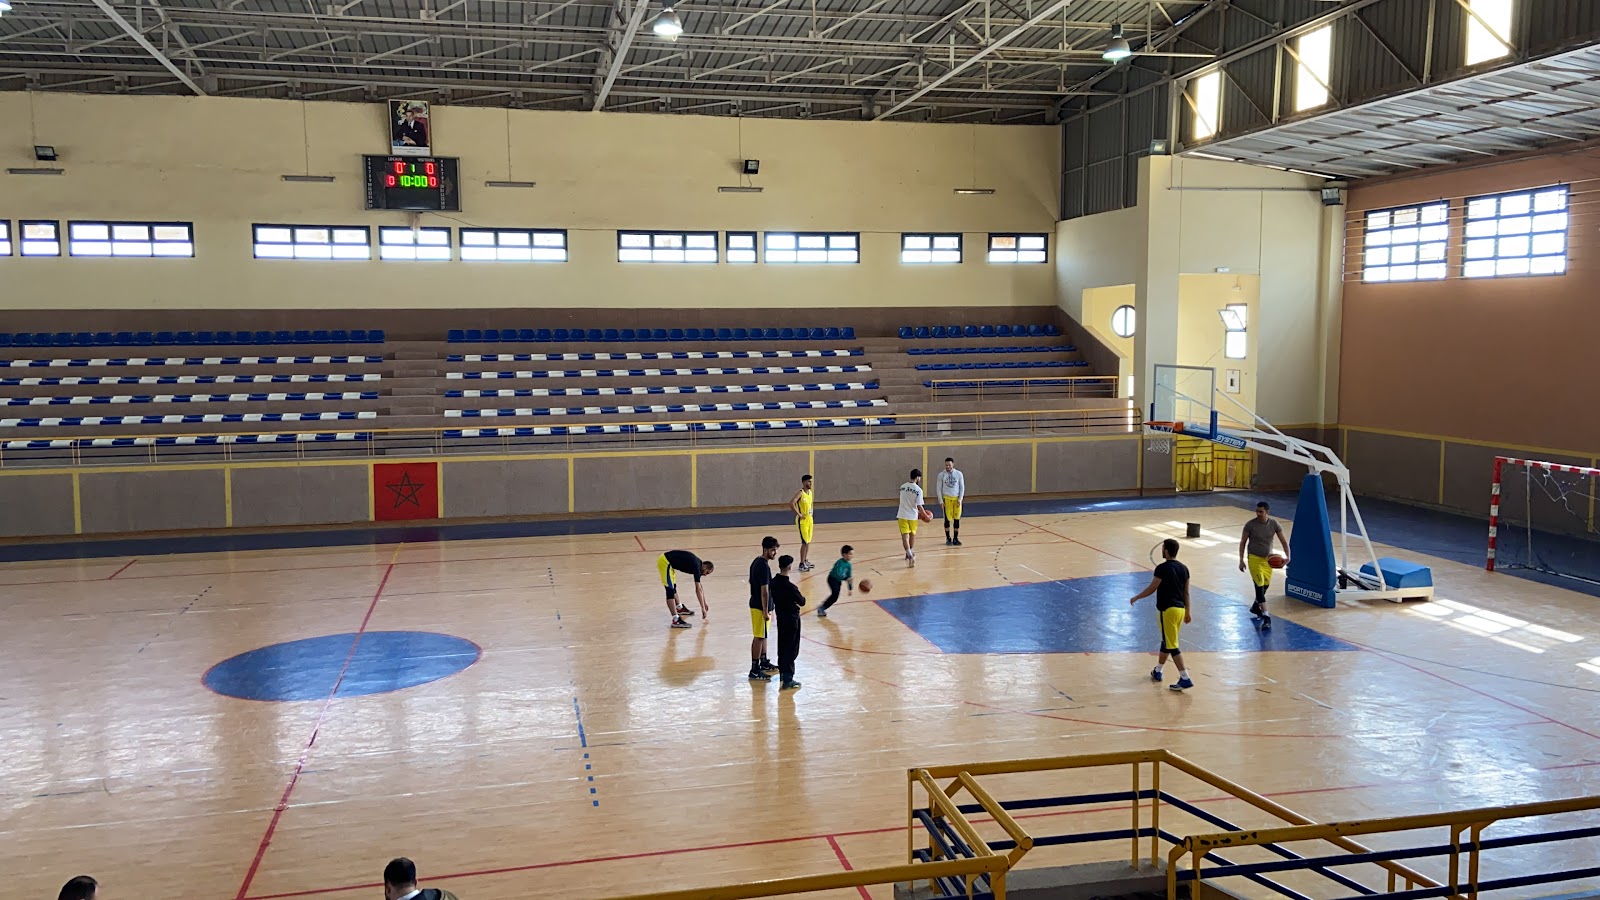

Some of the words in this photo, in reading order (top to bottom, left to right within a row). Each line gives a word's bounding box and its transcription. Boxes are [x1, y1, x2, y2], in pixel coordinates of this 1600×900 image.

[426, 163, 434, 174] 0
[388, 176, 395, 185] 0
[400, 175, 428, 187] 10:00
[430, 177, 436, 186] 0
[1216, 434, 1244, 447] SYSTEM
